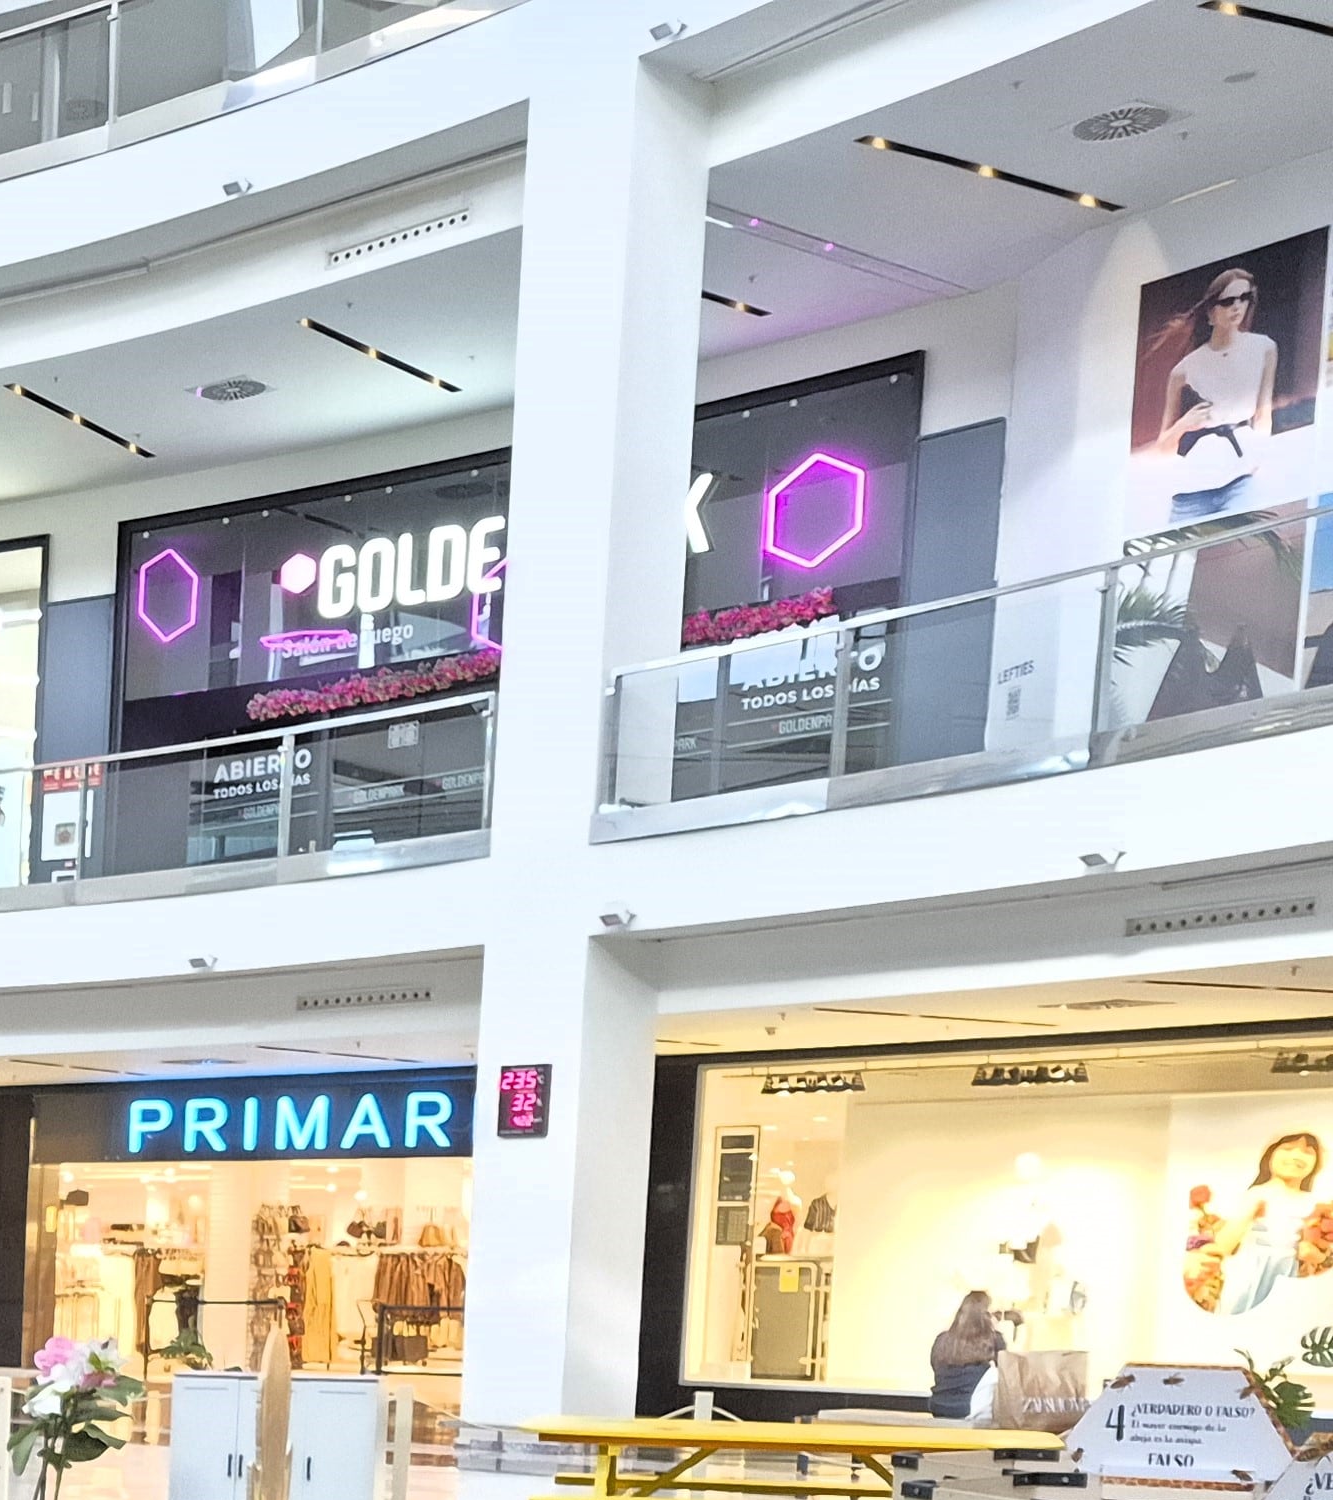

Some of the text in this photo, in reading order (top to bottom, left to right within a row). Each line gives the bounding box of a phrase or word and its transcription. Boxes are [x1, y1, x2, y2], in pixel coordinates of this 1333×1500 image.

[317, 515, 506, 619] GOLDE
[374, 624, 414, 646] uego
[997, 660, 1034, 685] LEFTIES
[741, 677, 880, 710] TODOS LOS ÍAS
[778, 714, 833, 734] GOLDENPA
[213, 748, 312, 783] ABIERO
[213, 783, 253, 800] TODOS
[255, 779, 278, 793] LOS
[127, 1090, 454, 1154] PRIMAR
[1105, 1404, 1125, 1441] 4
[1131, 1403, 1255, 1418] ¿VERDADERO O FALSO?
[1148, 1453, 1194, 1467] FALSO
[1305, 1472, 1333, 1495] ¿VE
